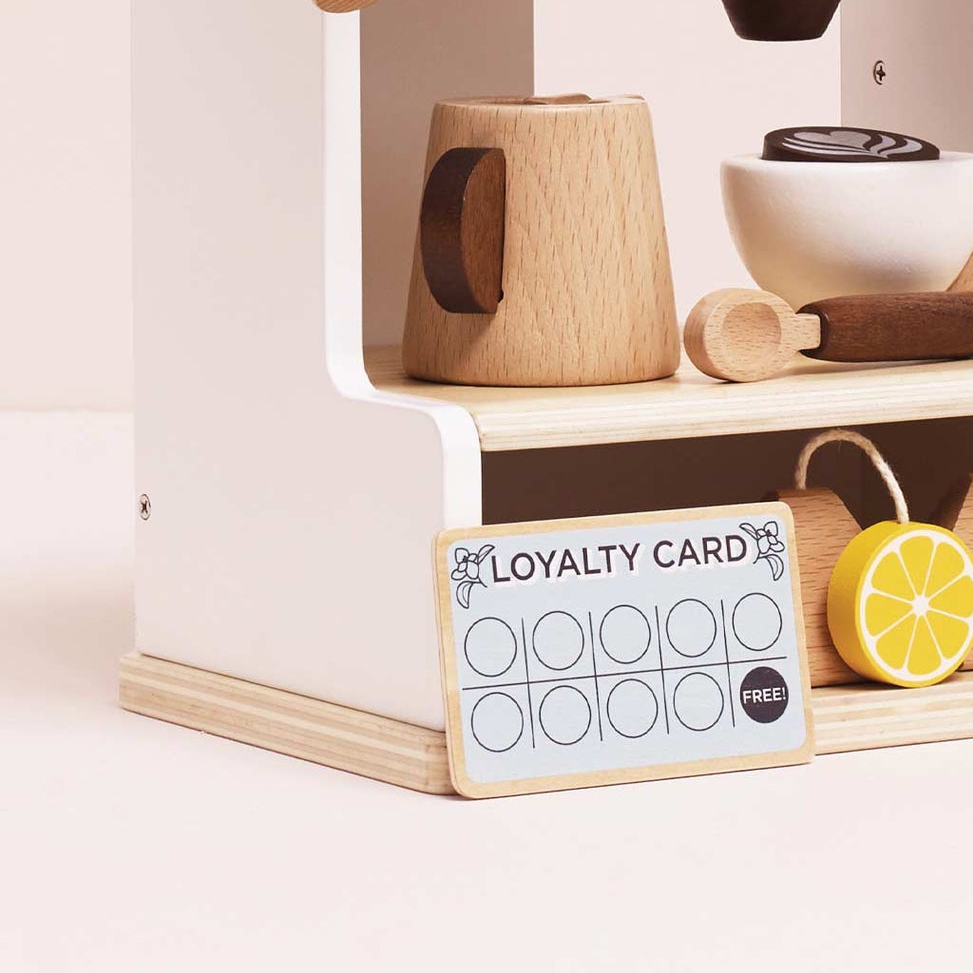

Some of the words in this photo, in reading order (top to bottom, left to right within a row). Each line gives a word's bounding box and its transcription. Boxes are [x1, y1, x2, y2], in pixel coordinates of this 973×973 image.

[490, 543, 641, 584] LOYALTY
[652, 534, 748, 569] CARD
[742, 686, 787, 703] FREE!
